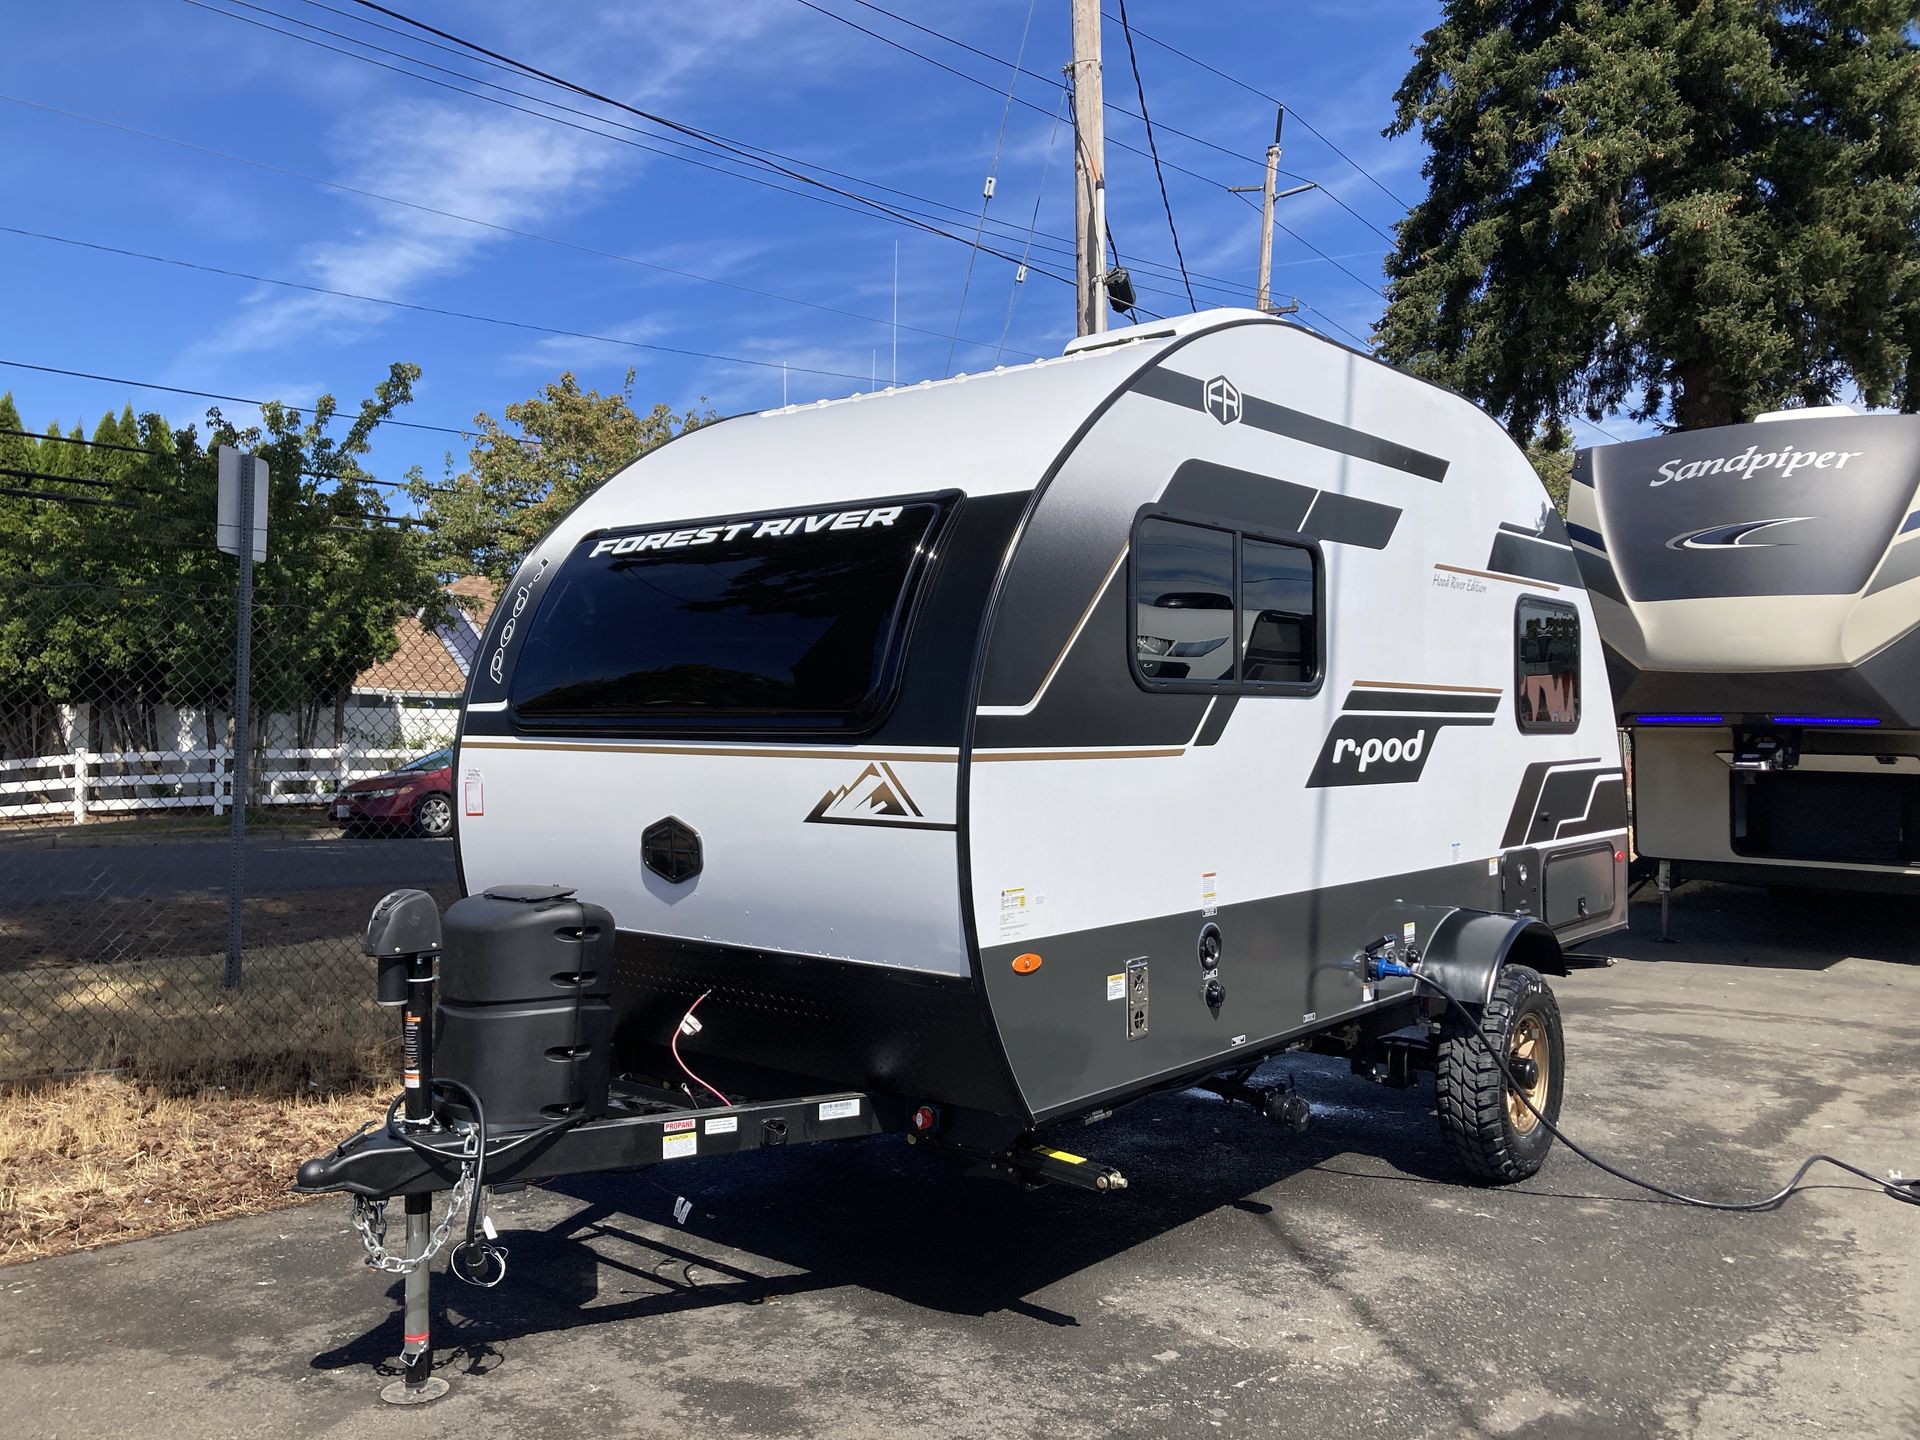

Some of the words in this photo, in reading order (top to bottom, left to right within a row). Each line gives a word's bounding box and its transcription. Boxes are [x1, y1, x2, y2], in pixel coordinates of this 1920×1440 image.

[1649, 445, 1865, 487] Sandpiper
[588, 522, 754, 558] FOREST
[752, 505, 904, 539] RIVER
[1432, 573, 1451, 587] Hood
[1450, 576, 1467, 590] River
[1466, 577, 1487, 593] Edition
[665, 1120, 693, 1130] PROPANE
